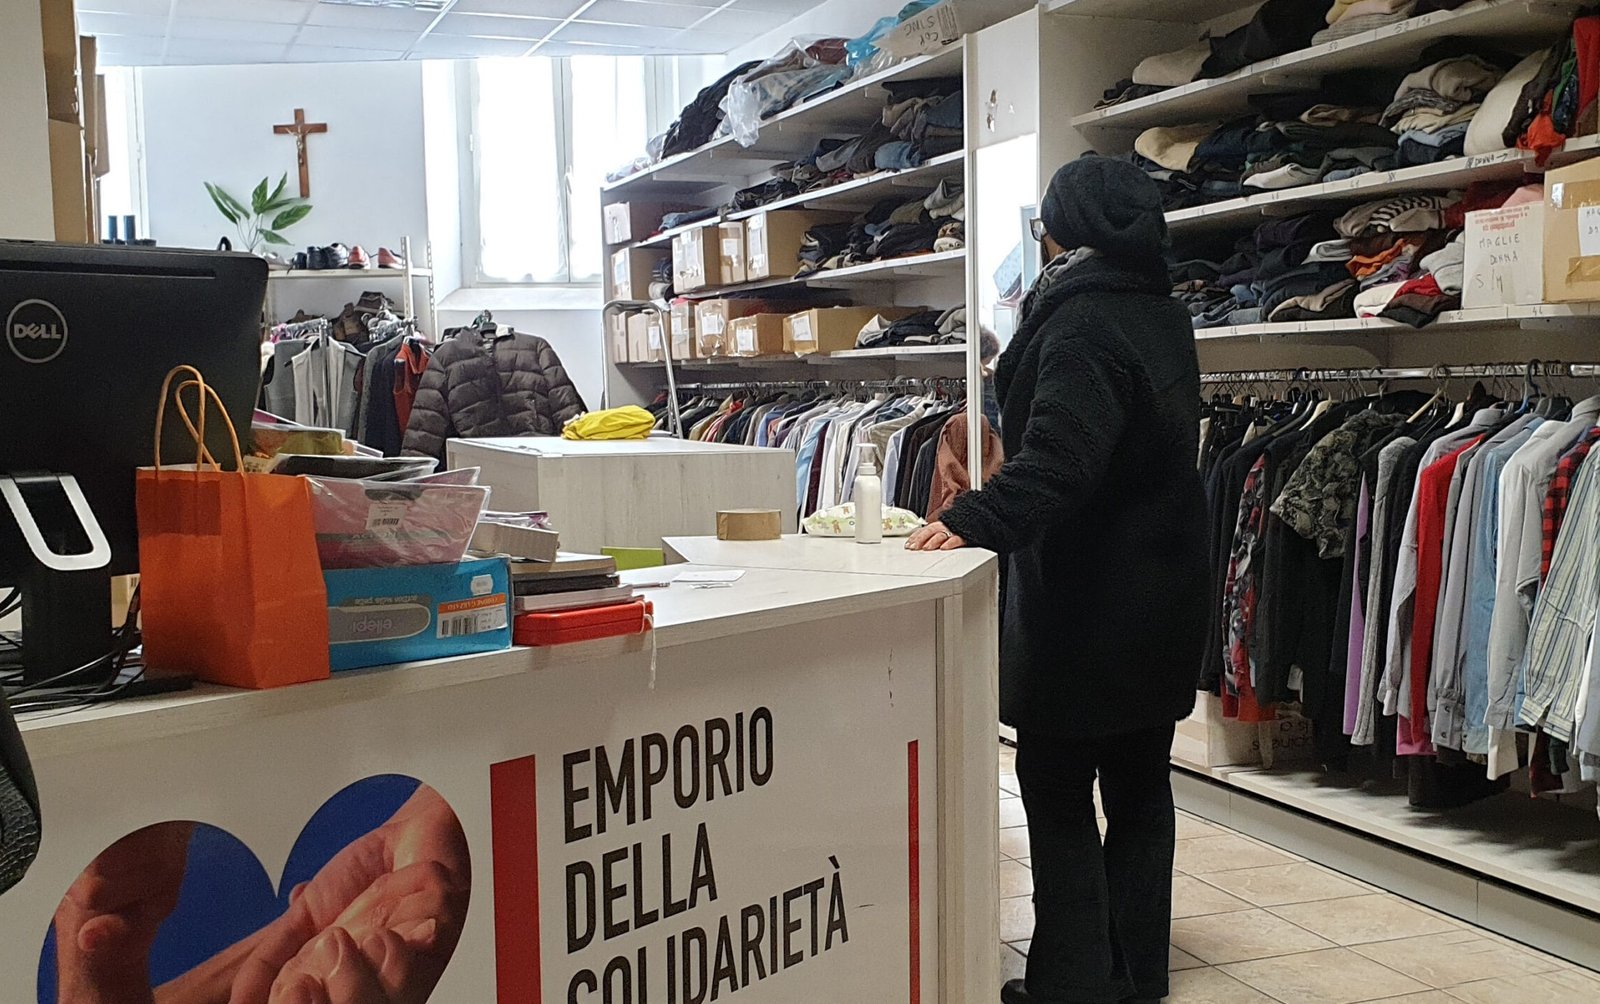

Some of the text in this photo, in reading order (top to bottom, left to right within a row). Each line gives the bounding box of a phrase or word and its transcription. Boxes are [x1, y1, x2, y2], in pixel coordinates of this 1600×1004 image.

[1479, 233, 1520, 248] MAGLIE
[13, 323, 62, 339] DELL
[352, 616, 393, 634] ellepi
[563, 706, 774, 844] EMPORIO
[565, 822, 719, 954] DELLA
